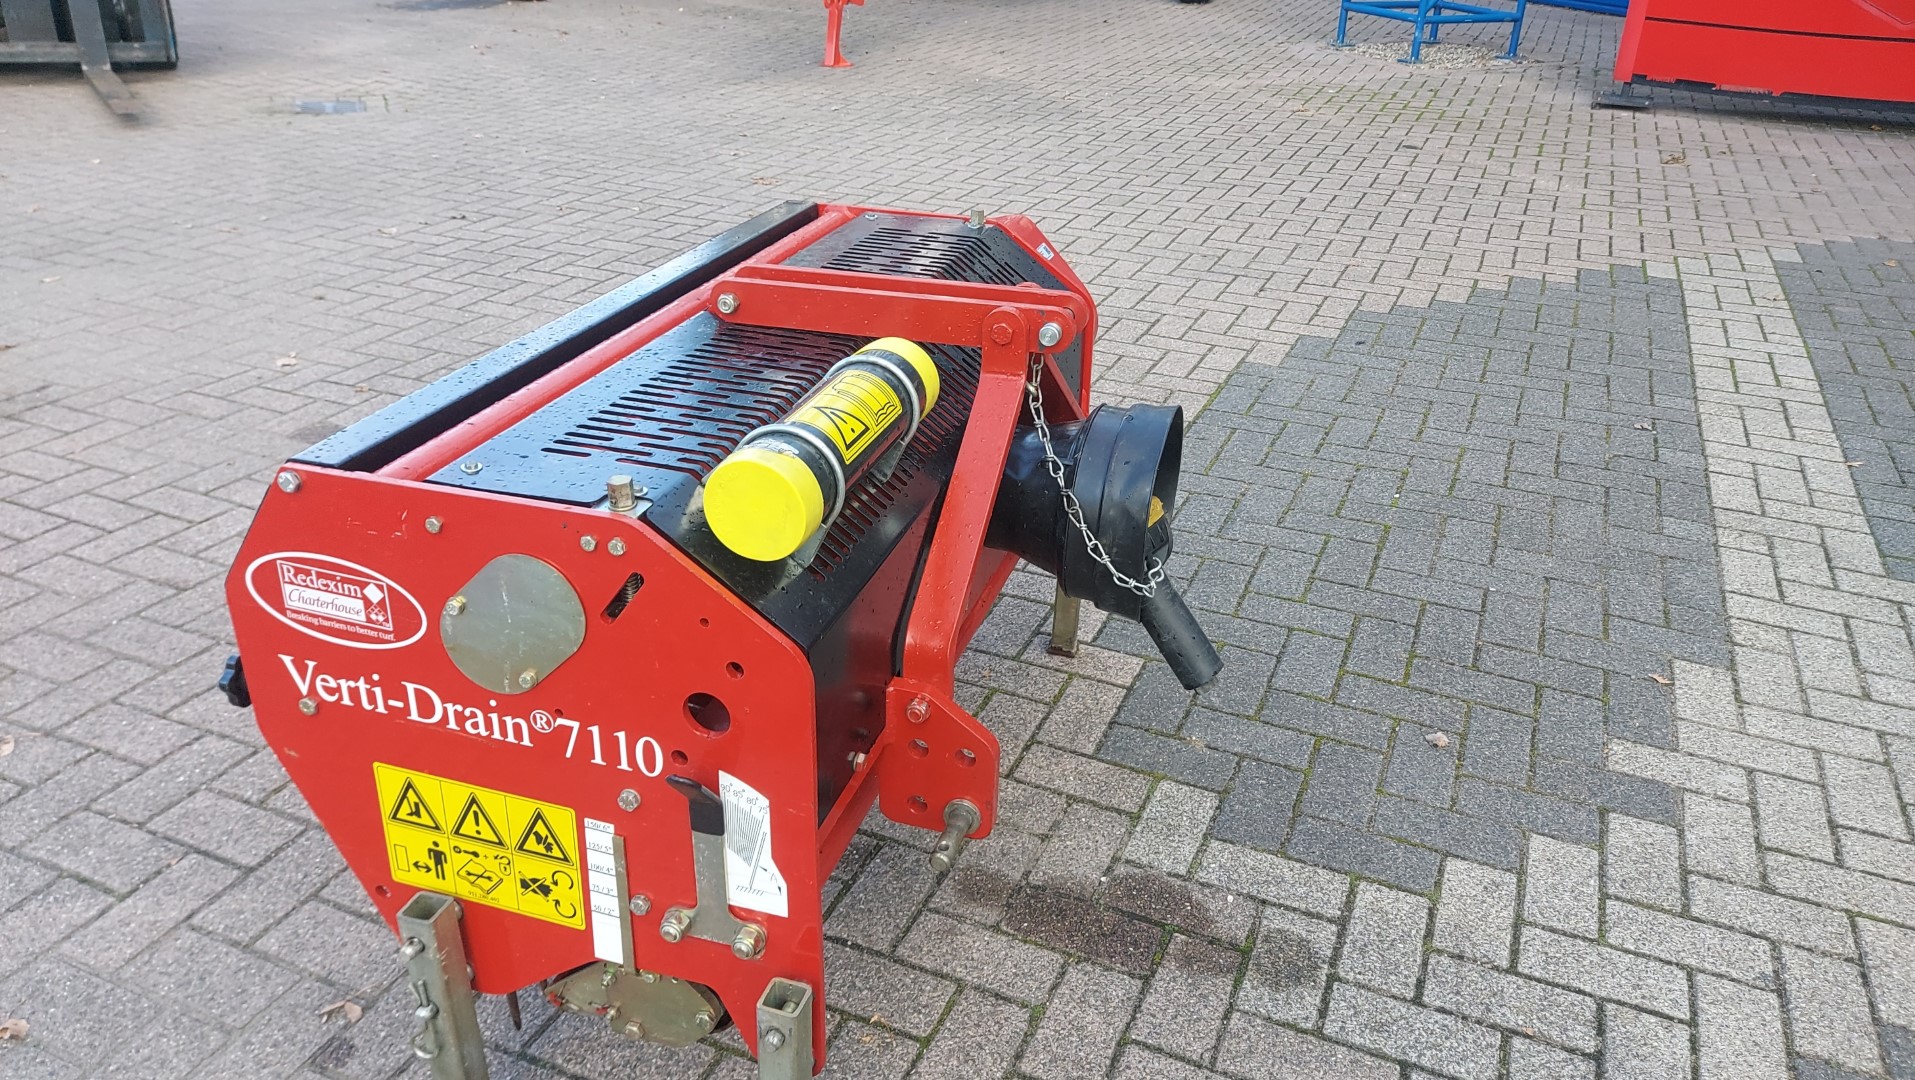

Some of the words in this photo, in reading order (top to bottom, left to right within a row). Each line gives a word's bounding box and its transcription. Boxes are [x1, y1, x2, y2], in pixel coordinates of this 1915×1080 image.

[282, 564, 362, 597] Redexim
[288, 588, 363, 616] Charterhouse
[286, 610, 319, 626] Breaking
[319, 617, 347, 631] barriers
[347, 624, 356, 633] to
[356, 626, 379, 638] better
[554, 718, 664, 778] 7110
